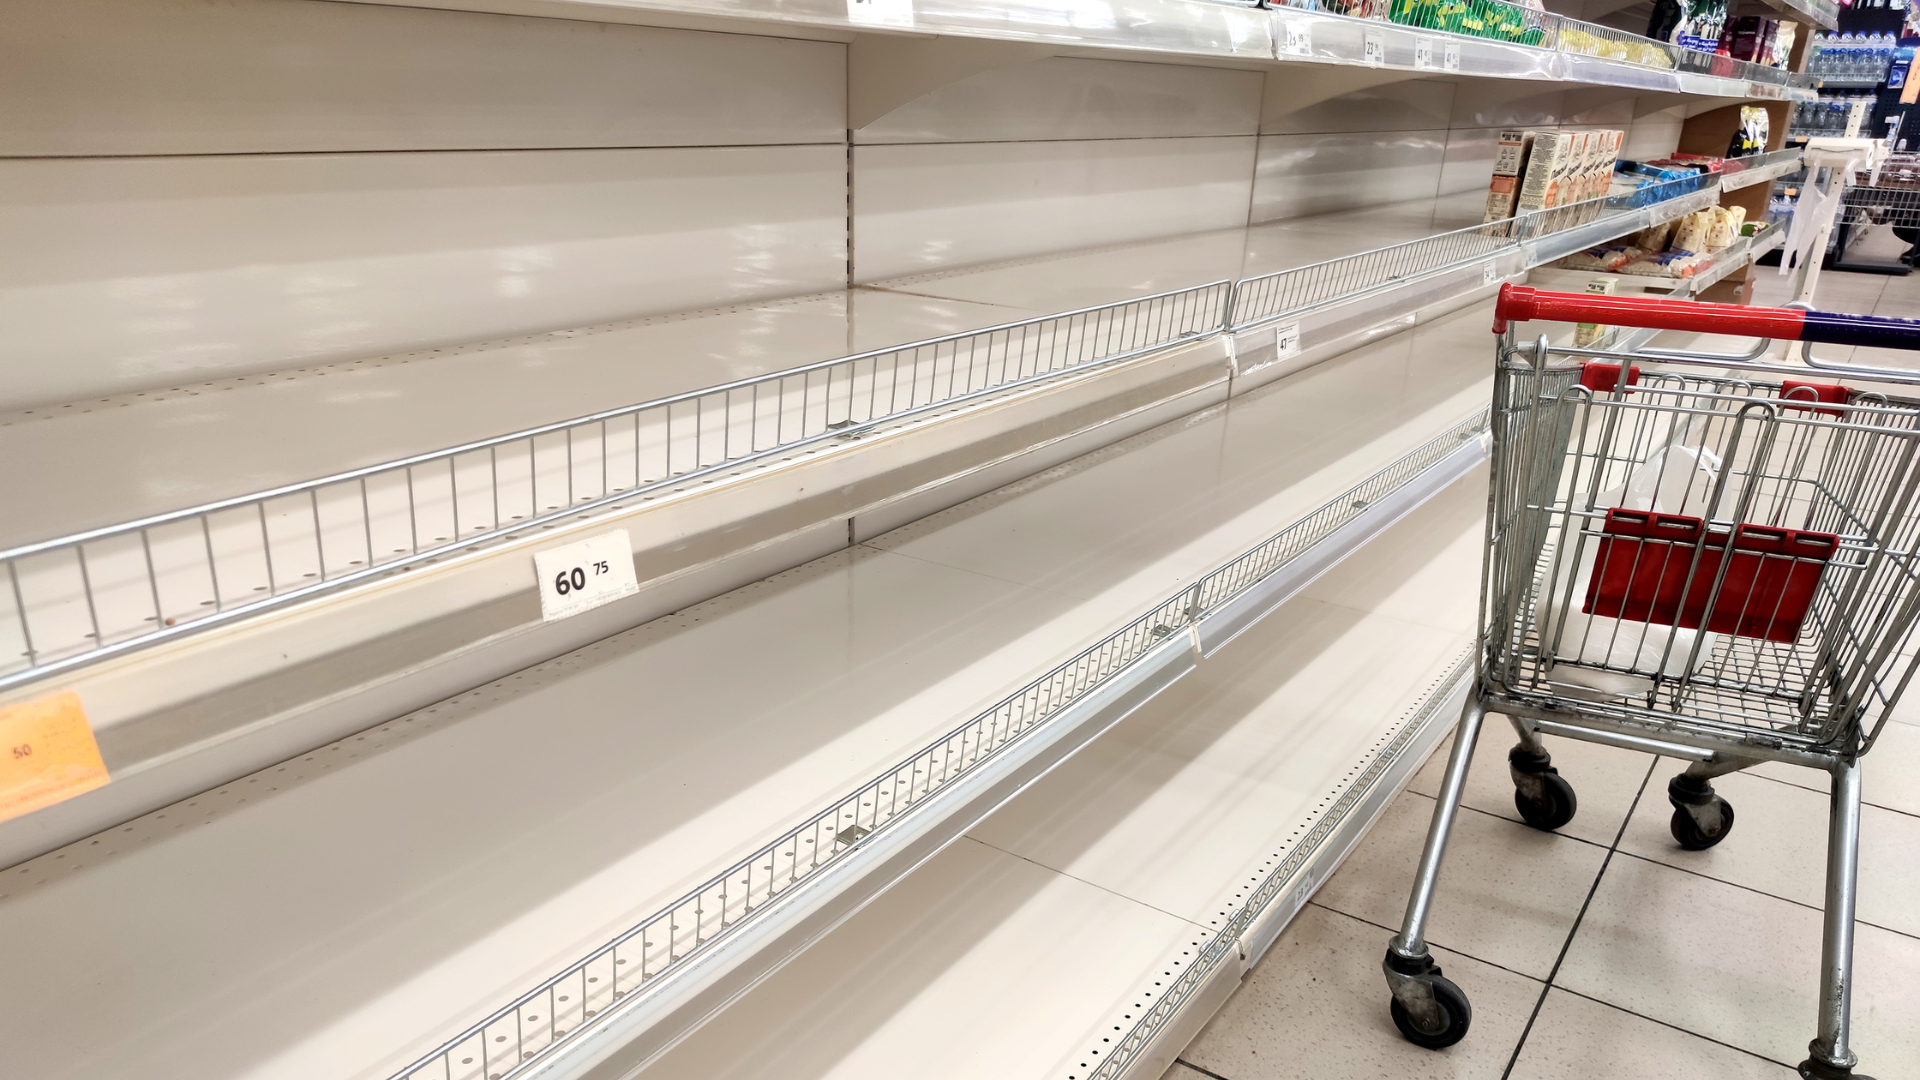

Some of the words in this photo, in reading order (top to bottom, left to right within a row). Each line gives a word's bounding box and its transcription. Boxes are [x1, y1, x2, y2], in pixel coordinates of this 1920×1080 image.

[1366, 41, 1374, 55] 23
[555, 566, 586, 596] 60
[592, 560, 609, 576] 75
[12, 743, 33, 760] 50
